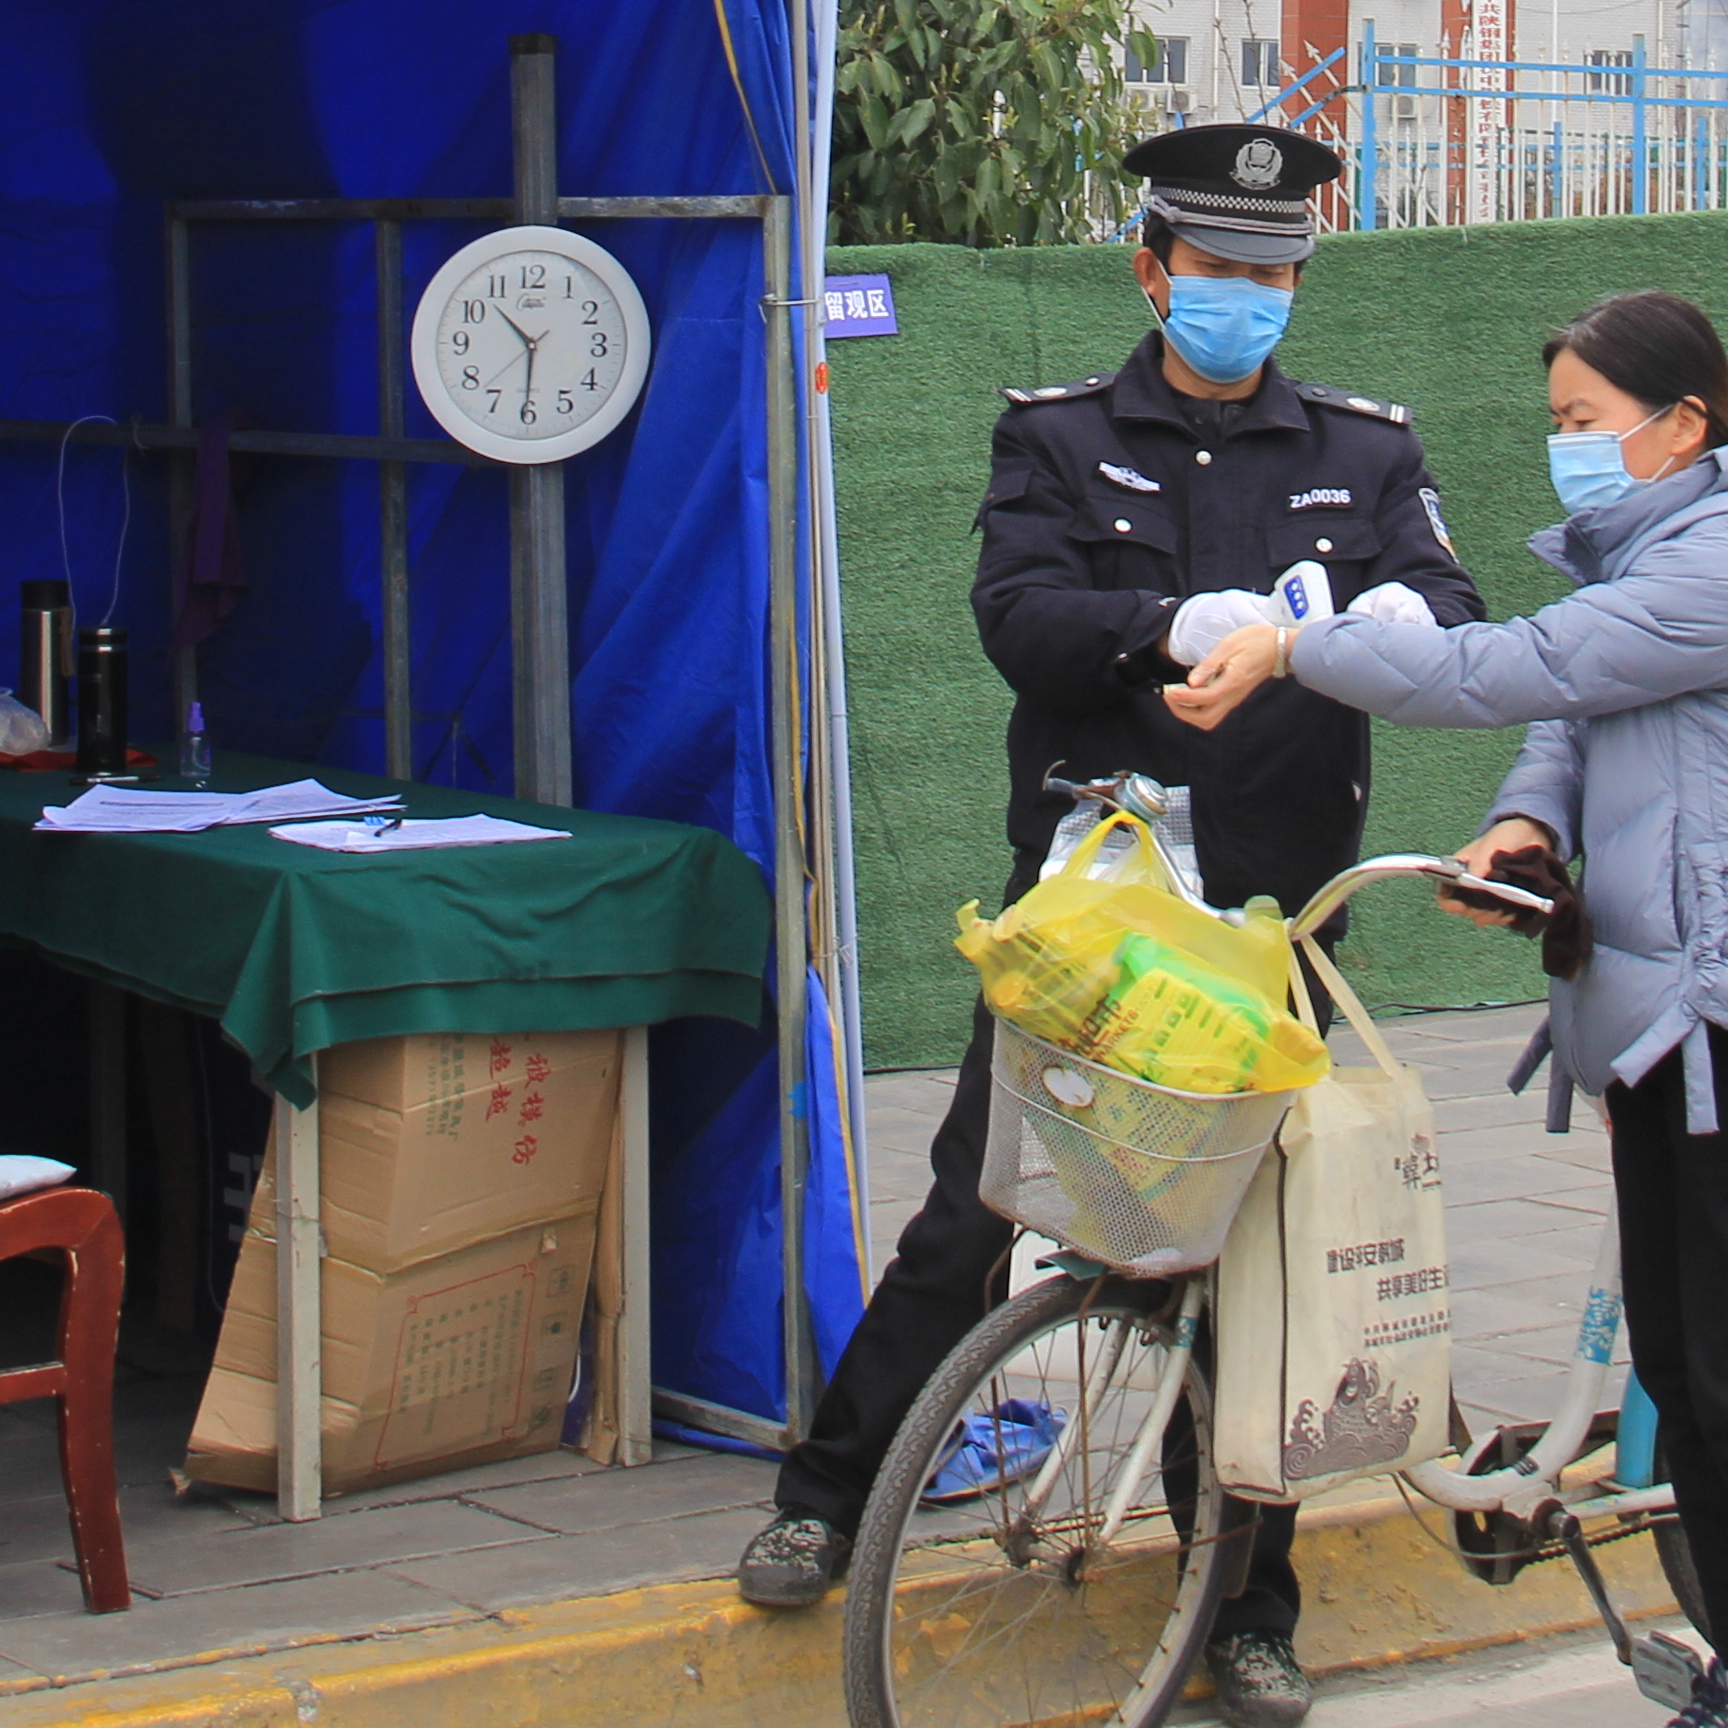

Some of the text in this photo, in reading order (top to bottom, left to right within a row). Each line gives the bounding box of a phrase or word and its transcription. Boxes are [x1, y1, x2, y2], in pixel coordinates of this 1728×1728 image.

[487, 275, 506, 298] 11
[520, 265, 546, 289] 12
[563, 275, 574, 299] 1
[462, 299, 485, 323] 10
[581, 300, 598, 325] 2
[824, 289, 890, 321] 留观区
[453, 331, 469, 356] 9
[590, 332, 607, 357] 3
[461, 365, 480, 390] 8
[580, 367, 598, 391] 4
[486, 389, 502, 413] 7
[520, 400, 537, 425] 6
[556, 390, 573, 414] 5
[1289, 488, 1351, 509] ZA0036
